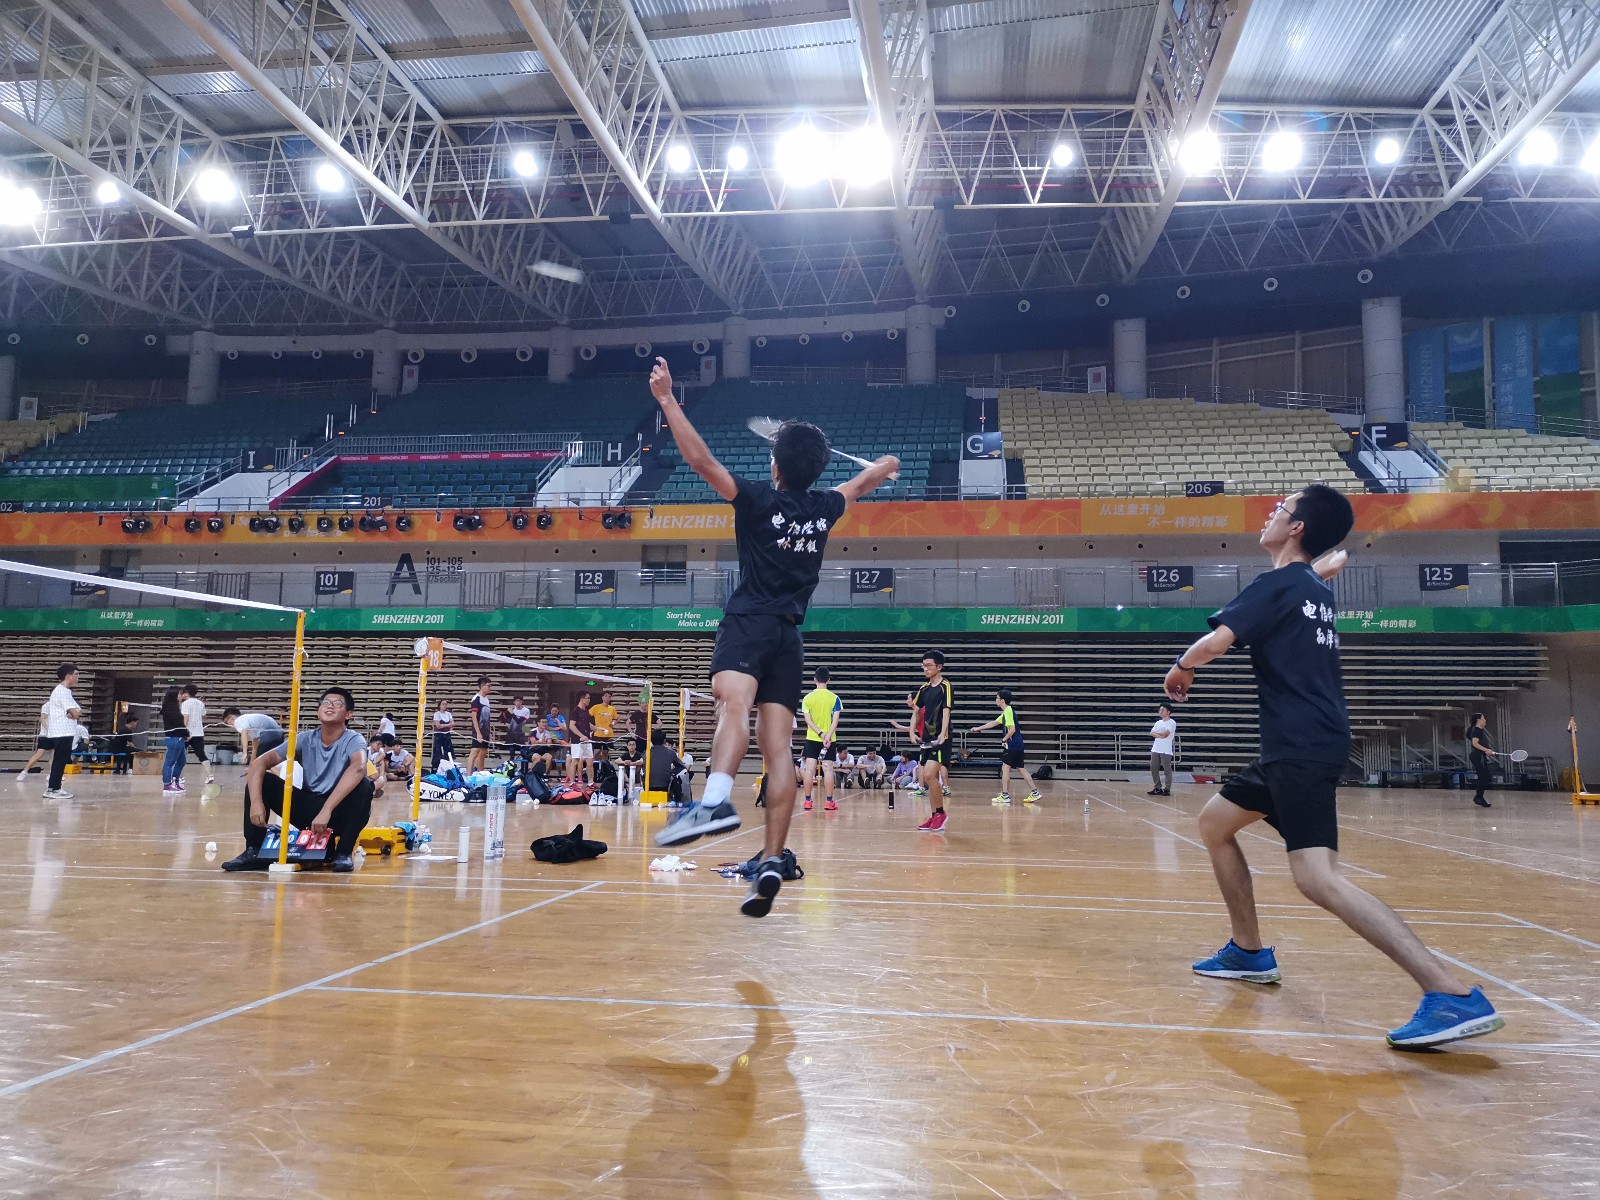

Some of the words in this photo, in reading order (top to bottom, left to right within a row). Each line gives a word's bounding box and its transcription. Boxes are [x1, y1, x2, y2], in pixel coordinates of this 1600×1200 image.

[966, 434, 984, 454] G
[1371, 426, 1387, 450] F
[607, 442, 622, 461] H
[247, 451, 256, 469] I
[1186, 484, 1212, 494] 206
[363, 496, 382, 507] 201
[642, 514, 728, 529] SHENZHEN
[1147, 515, 1229, 529] 不一样的精彩
[426, 556, 463, 566] 101-105
[319, 573, 339, 587] 101
[386, 552, 422, 596] A
[578, 572, 603, 585] 128
[854, 571, 881, 584] 127
[1151, 569, 1180, 583] 126
[1424, 567, 1454, 581] 125
[372, 614, 425, 624] SHENZHEN
[424, 614, 445, 624] 2011
[666, 611, 683, 619] Start
[684, 611, 701, 619] Here
[981, 614, 1041, 625] SHENZHEN
[1042, 614, 1065, 625] 2011
[1336, 610, 1374, 620] 这里开始
[677, 619, 697, 627] Make
[704, 618, 720, 627] Diff
[1361, 619, 1417, 629] 不一样的精彩
[428, 649, 440, 668] 18
[428, 789, 455, 801] YONEX
